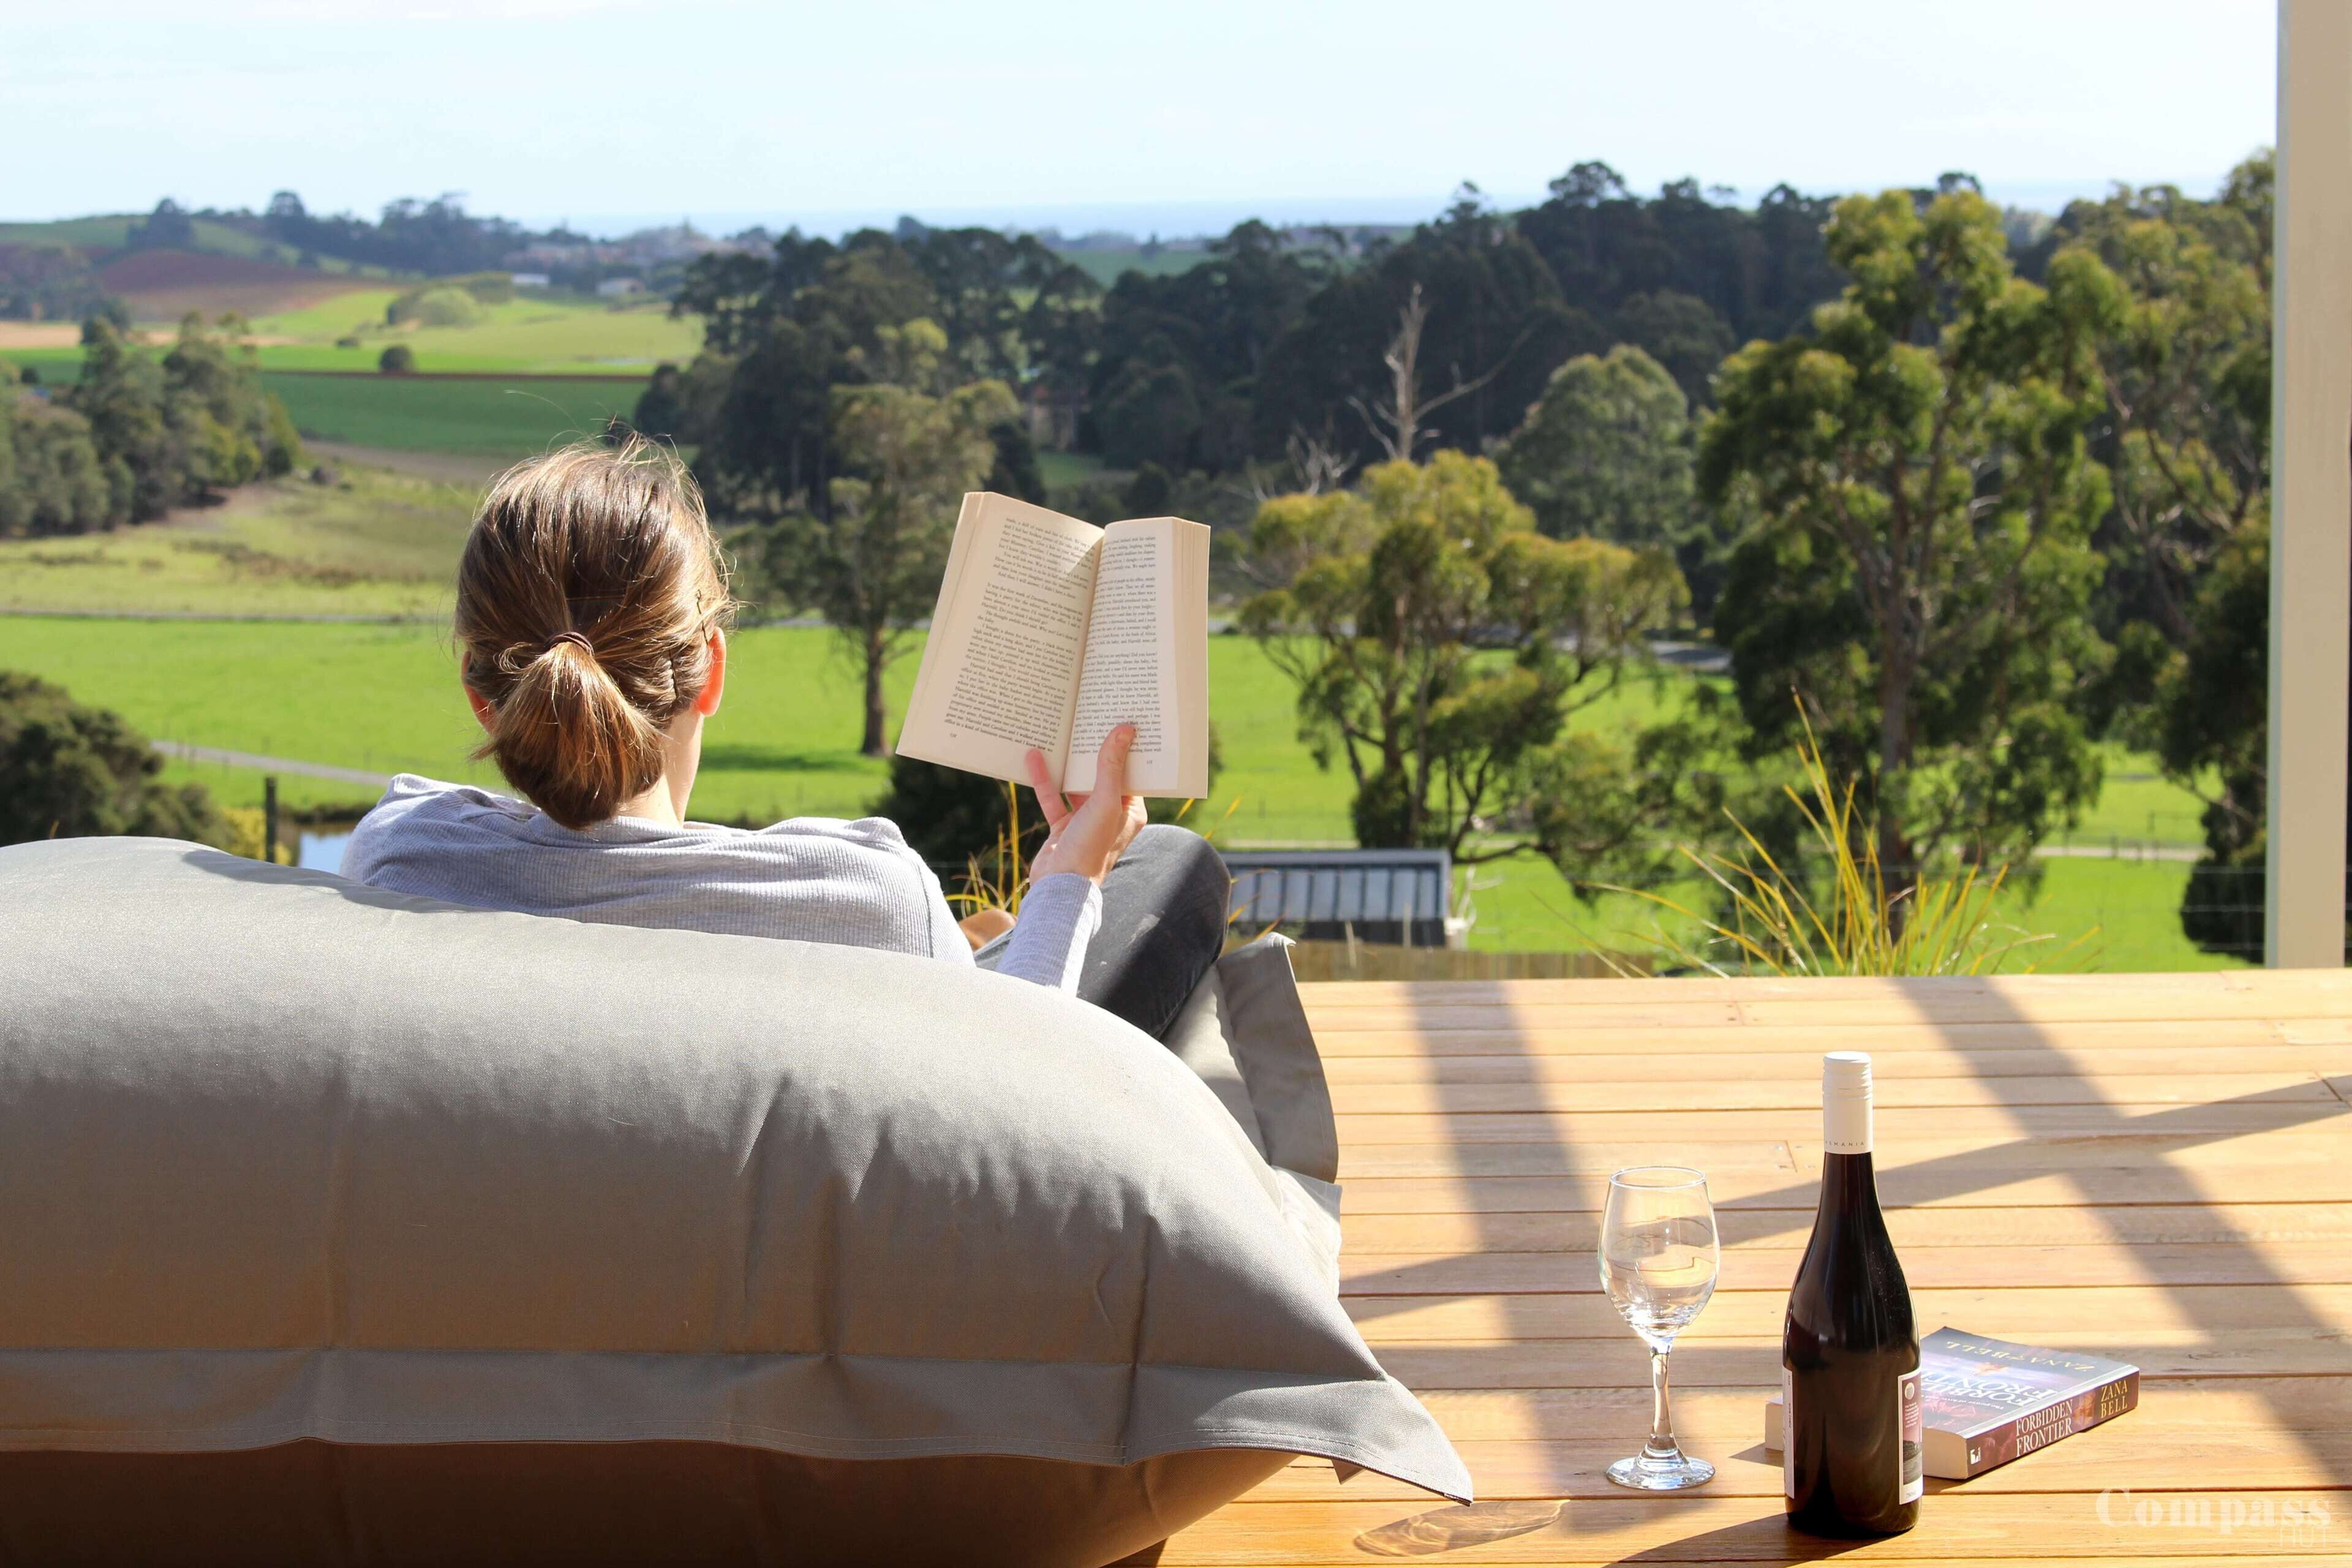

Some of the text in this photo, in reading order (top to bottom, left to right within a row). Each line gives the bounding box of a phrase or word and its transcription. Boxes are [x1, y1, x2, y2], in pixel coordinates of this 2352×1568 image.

[1947, 1341, 2095, 1372] ZANA BELL
[1921, 1371, 2058, 1400] FRONTI
[1921, 1382, 2032, 1407] FORBID
[2101, 1380, 2128, 1403] ZANA
[2016, 1400, 2073, 1436] FORBIDDEN
[2100, 1396, 2128, 1419] BELL
[2016, 1417, 2073, 1458] FRONTIER
